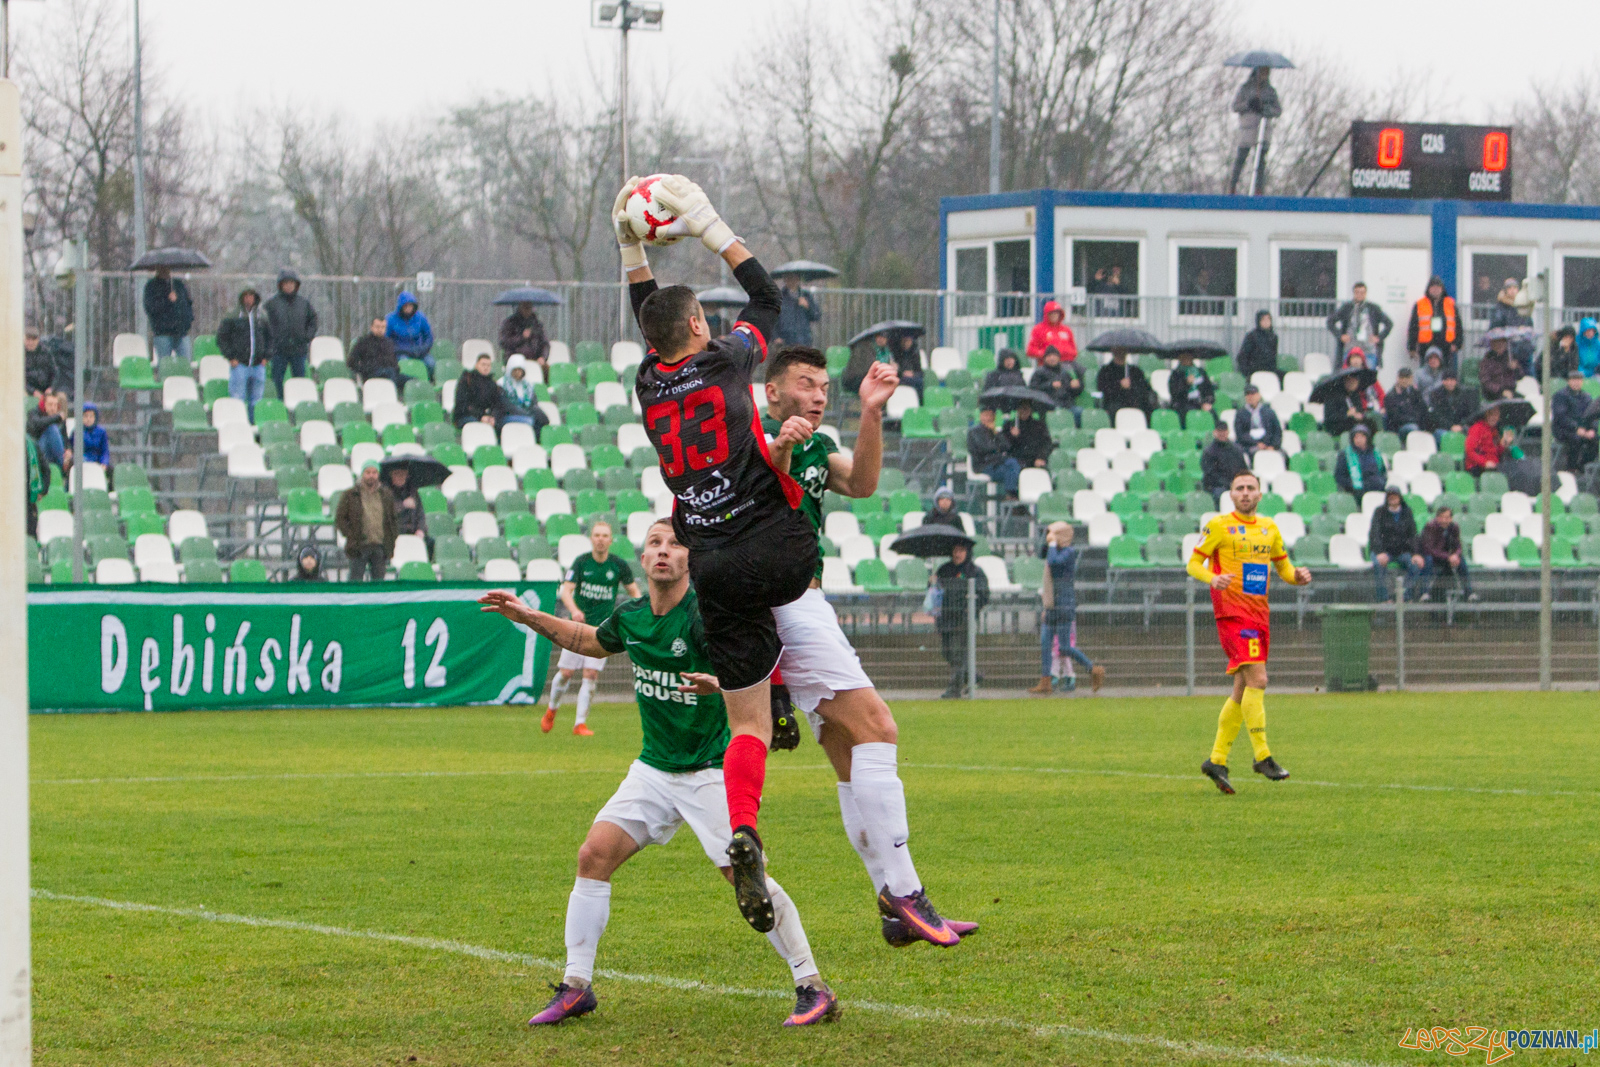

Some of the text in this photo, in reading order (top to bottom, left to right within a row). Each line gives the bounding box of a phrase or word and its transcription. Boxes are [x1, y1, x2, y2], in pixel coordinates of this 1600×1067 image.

[1377, 128, 1404, 169] 0
[1421, 133, 1446, 153] CZAS
[1482, 132, 1509, 172] 0
[1352, 168, 1412, 190] GOSPODARZE
[1468, 169, 1501, 192] GOŚCIE
[671, 378, 703, 395] DESIGN
[646, 385, 729, 478] 33
[1249, 638, 1260, 658] 6
[100, 613, 450, 711] Dębińska 12
